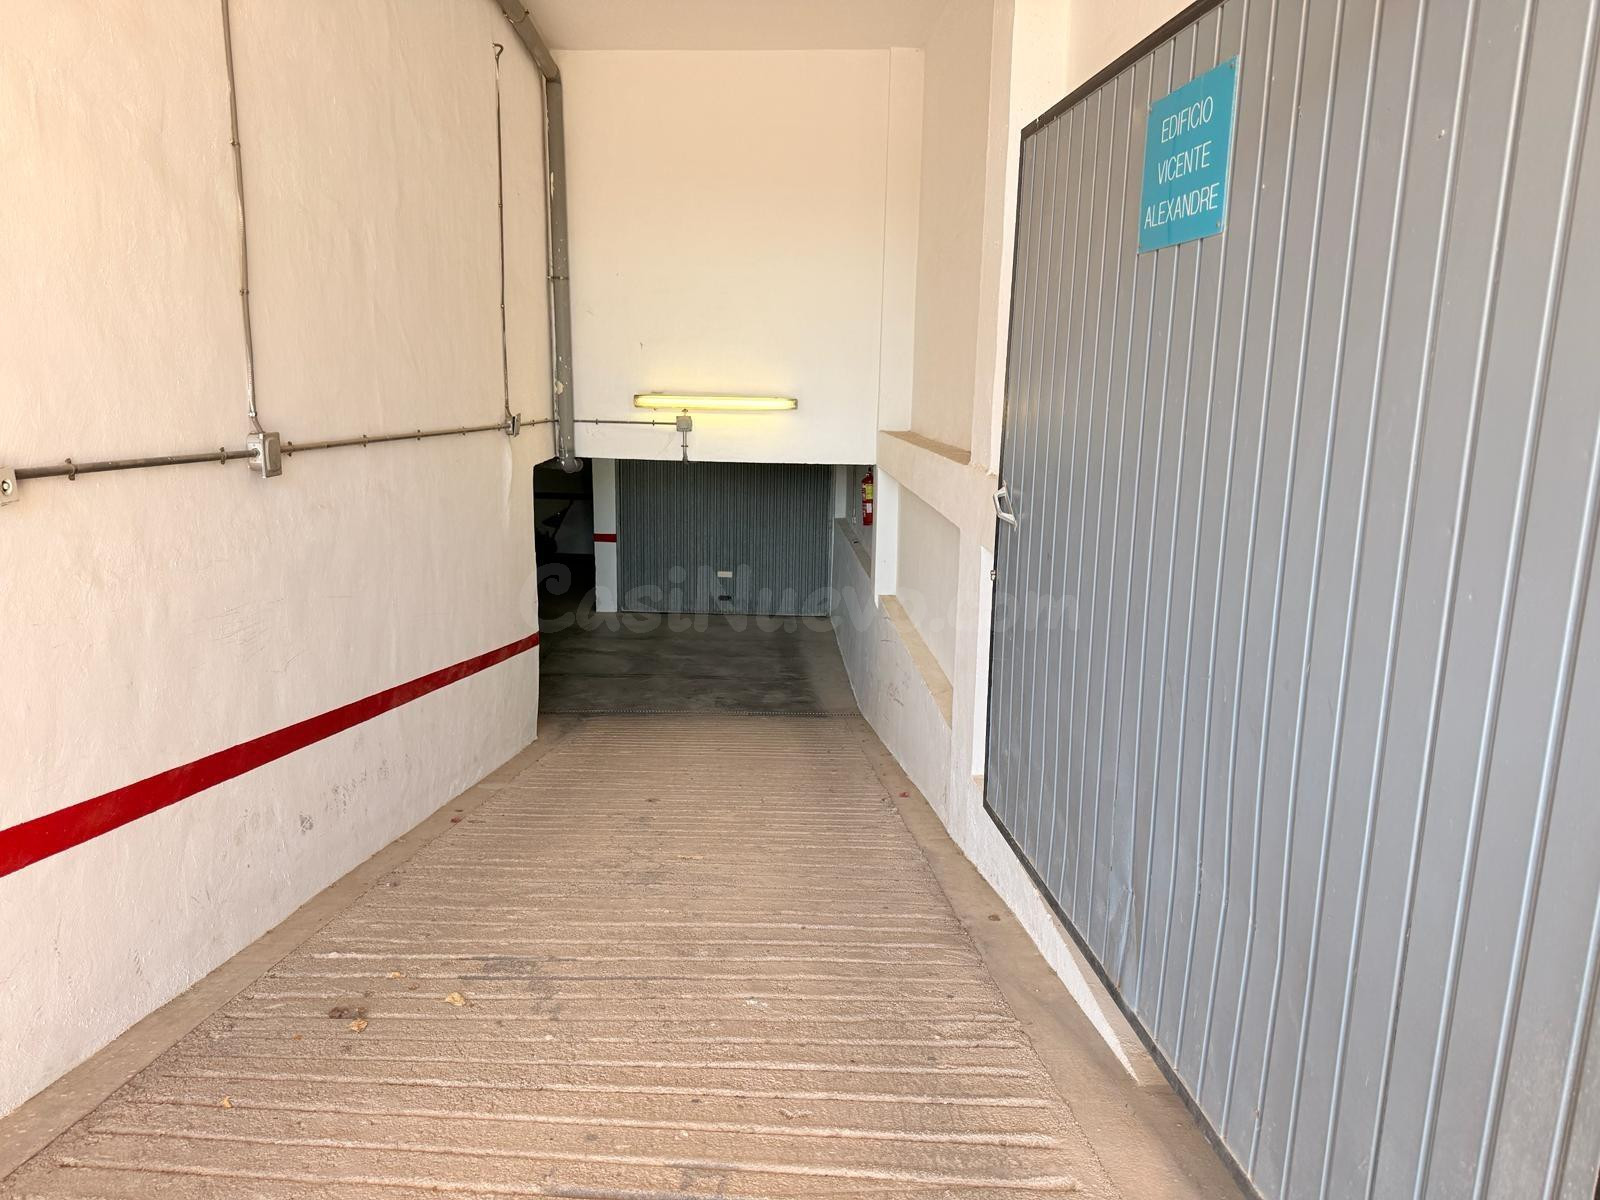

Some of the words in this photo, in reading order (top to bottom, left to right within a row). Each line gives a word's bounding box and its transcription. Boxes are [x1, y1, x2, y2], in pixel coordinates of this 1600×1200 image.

[1161, 96, 1213, 143] EDIFICIO
[1158, 140, 1212, 185] VICENTE
[1144, 182, 1220, 229] ALEXANDRE
